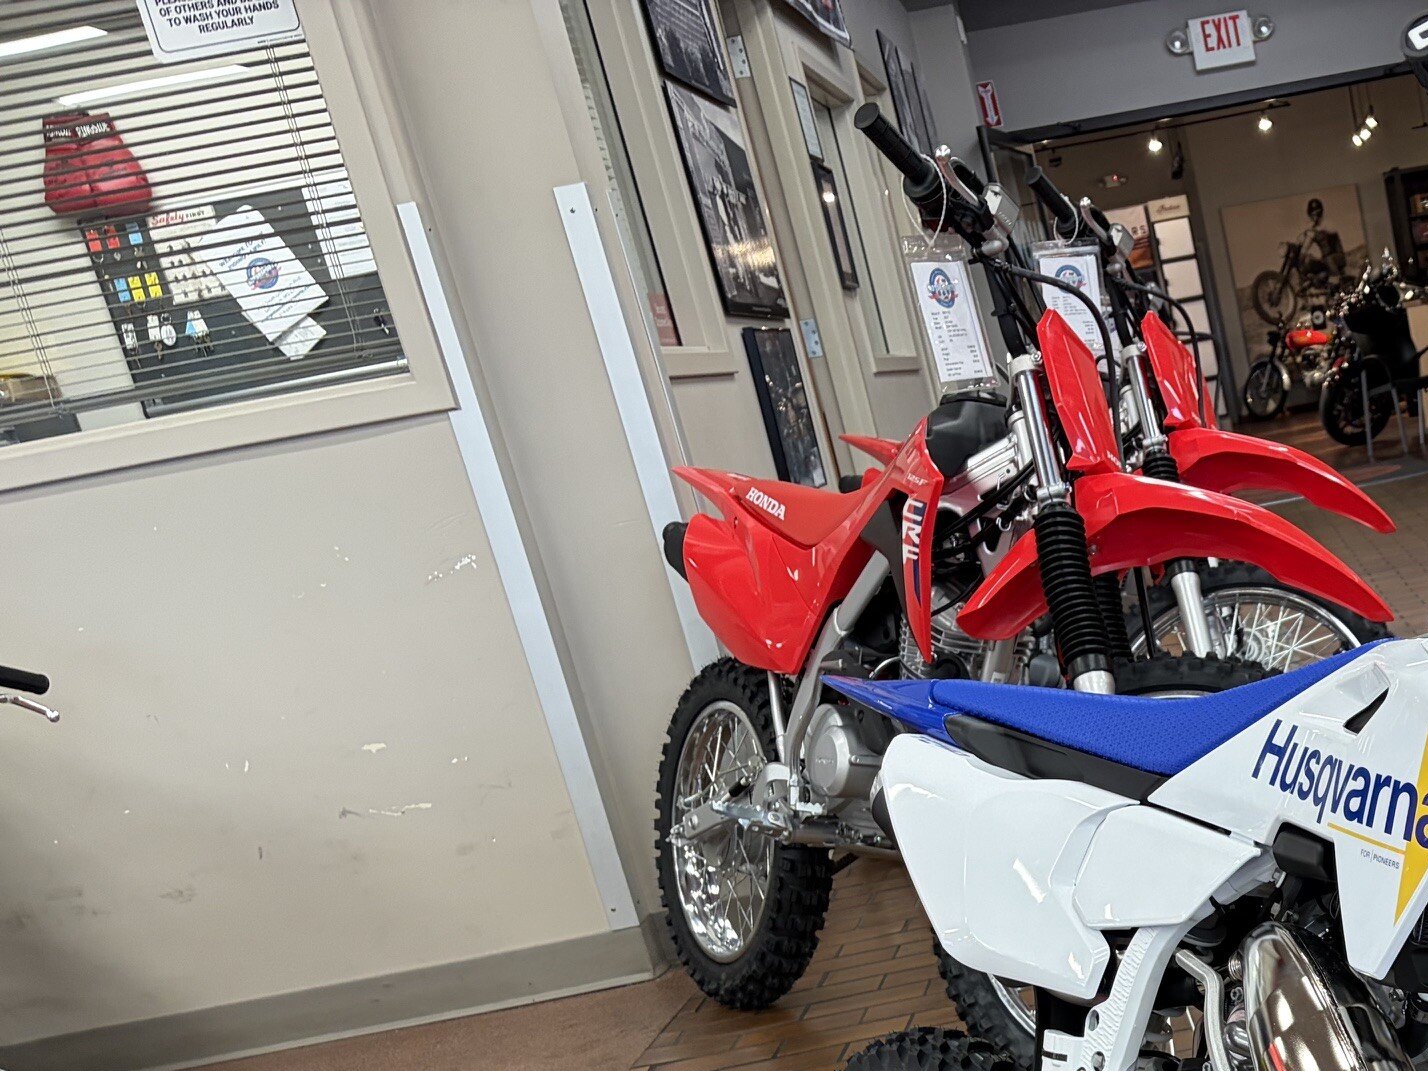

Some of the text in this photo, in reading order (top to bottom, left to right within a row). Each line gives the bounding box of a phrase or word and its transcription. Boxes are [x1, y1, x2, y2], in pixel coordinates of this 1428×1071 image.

[159, 7, 172, 17] OF
[175, 0, 214, 15] OTHERS
[166, 0, 280, 28] TO WASH YOUR HANDS
[198, 15, 254, 34] REGULARLY
[1201, 15, 1241, 53] EXIT
[745, 486, 786, 521] HONDA
[902, 498, 923, 564] CRF
